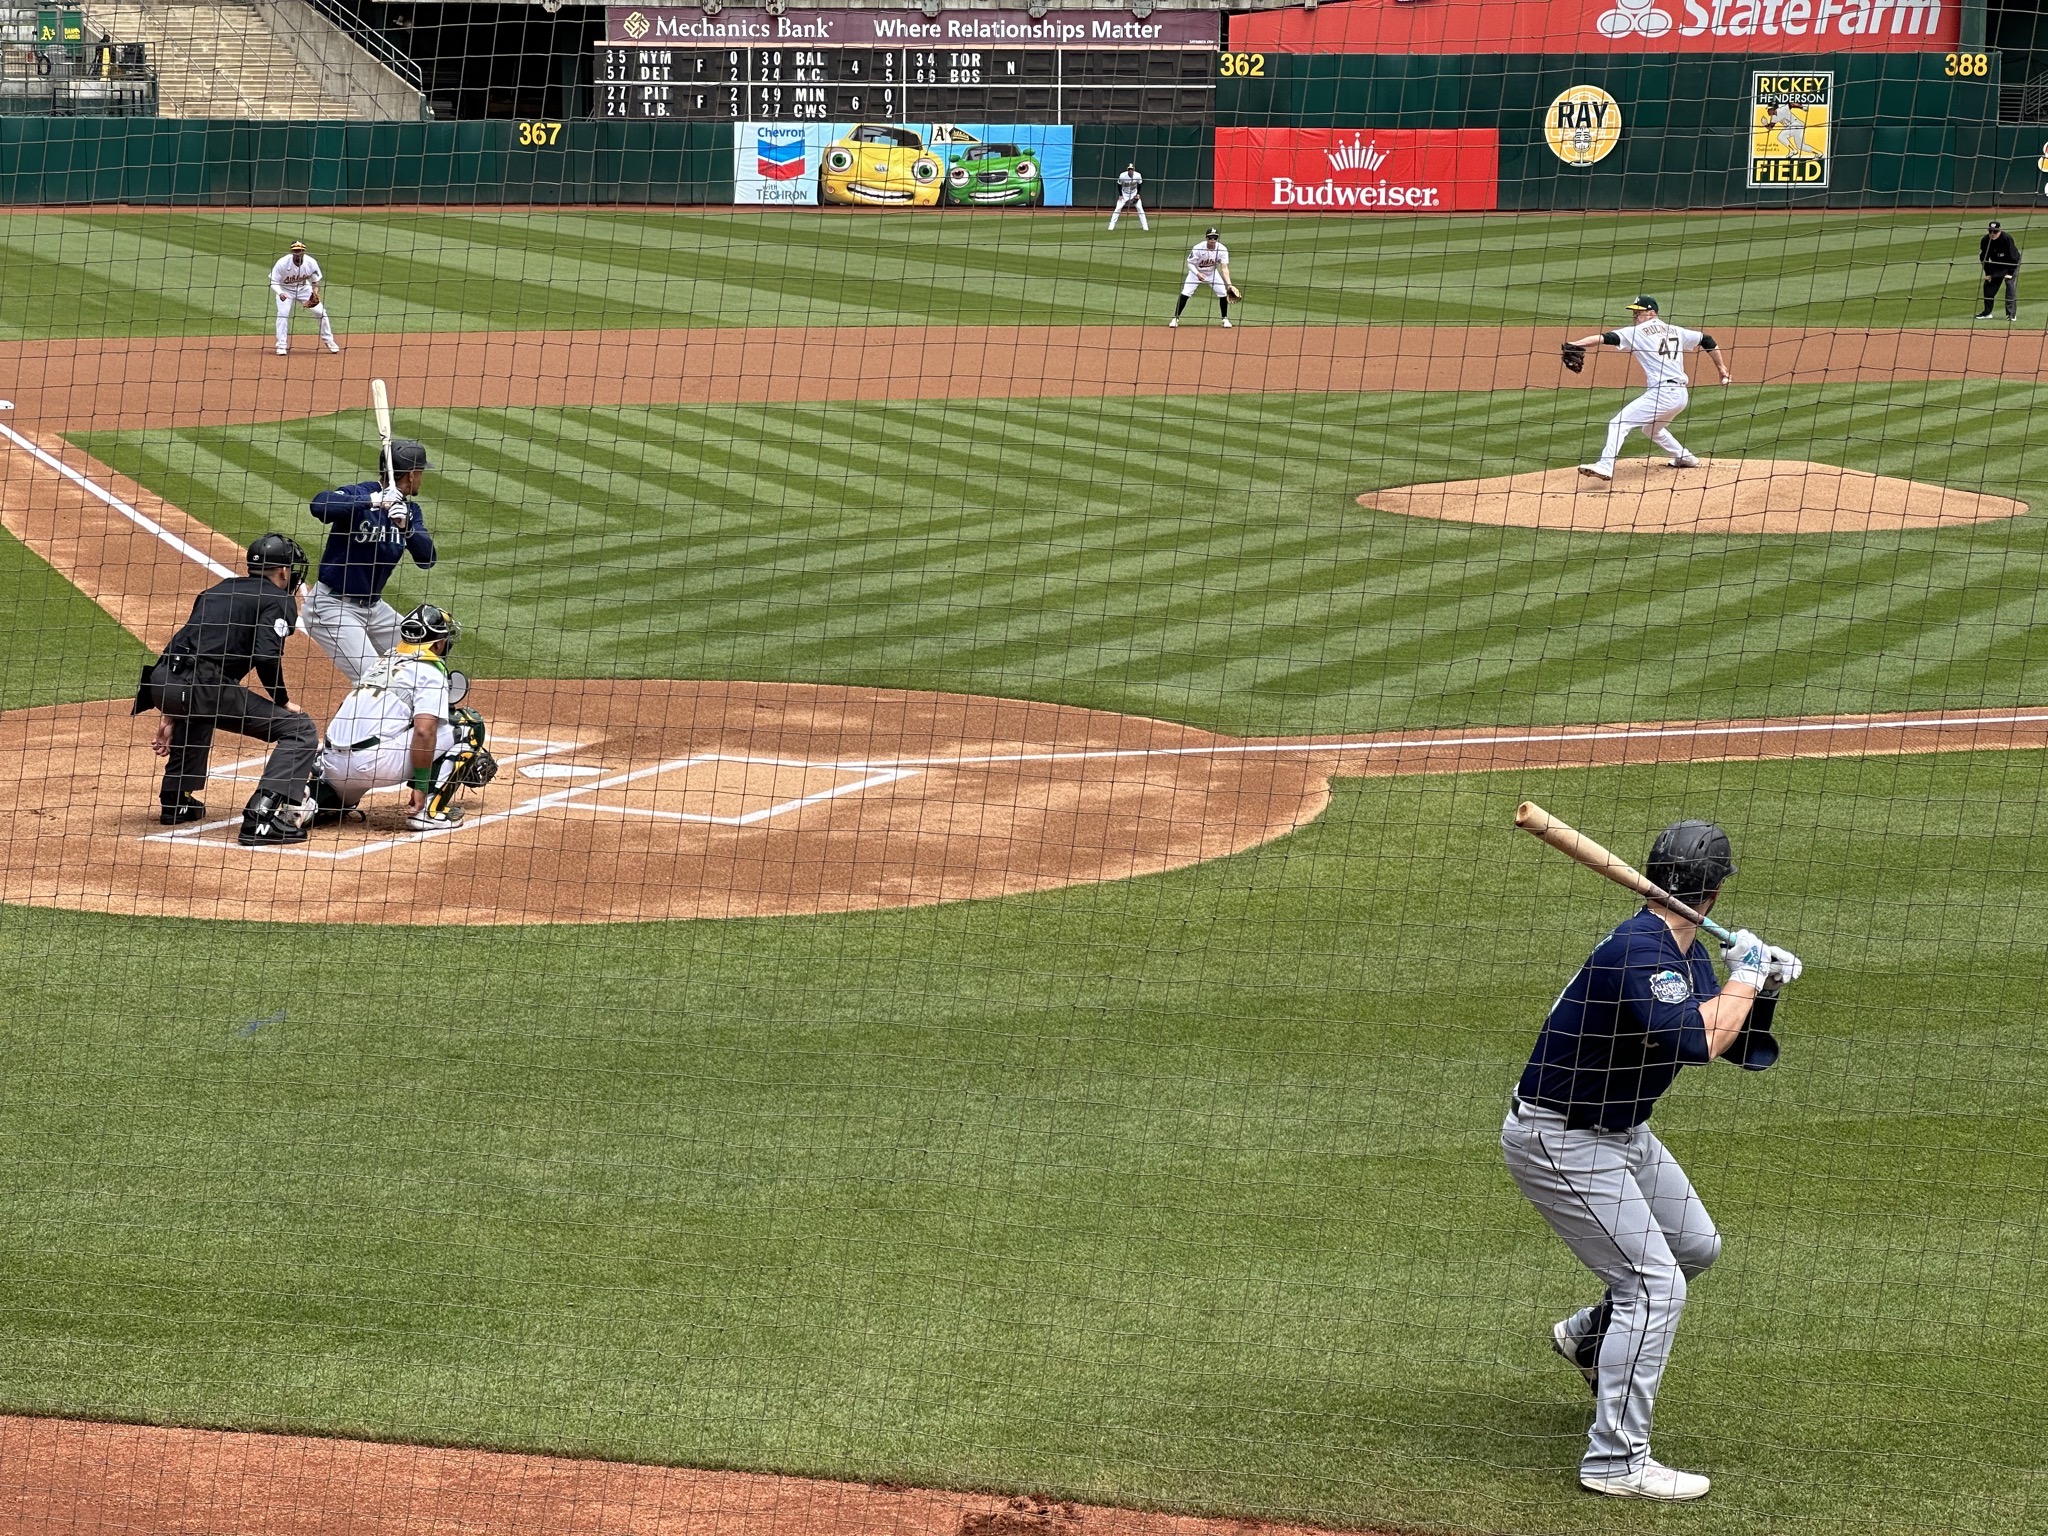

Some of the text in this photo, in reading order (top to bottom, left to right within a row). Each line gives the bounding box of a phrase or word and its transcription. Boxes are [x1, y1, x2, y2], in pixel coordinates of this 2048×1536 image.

[656, 16, 830, 38] Mechanics Bank
[874, 19, 1162, 42] Where Relationships Matter
[606, 50, 738, 64] 35 NYM 0
[761, 52, 893, 67] 30 BAL 8
[950, 53, 980, 67] TOR
[697, 60, 704, 72] F
[852, 61, 858, 74] 4
[1007, 61, 1015, 74] N
[1220, 53, 1265, 77] 362
[1945, 53, 1988, 76] 388
[607, 66, 738, 81] 57 DET 2
[761, 68, 781, 81] 24
[885, 69, 893, 82] 5
[916, 69, 980, 83] 66 BOS
[1760, 78, 1825, 93] RICKEY
[608, 87, 738, 101] 27 PIT 2
[761, 87, 892, 102] 49 MIN 0
[1760, 94, 1825, 103] HENDERSON
[697, 96, 704, 108] F
[852, 97, 859, 110] 6
[607, 103, 738, 116] 24 T.B. 3
[761, 104, 892, 118] 27 CWS 2
[1558, 102, 1609, 128] RAY
[519, 123, 561, 146] 367
[757, 127, 805, 137] Chevron
[1756, 160, 1822, 181] FIELD
[756, 189, 807, 200] TECHRON
[1272, 177, 1433, 206] Budweiser
[1659, 338, 1679, 360] 47
